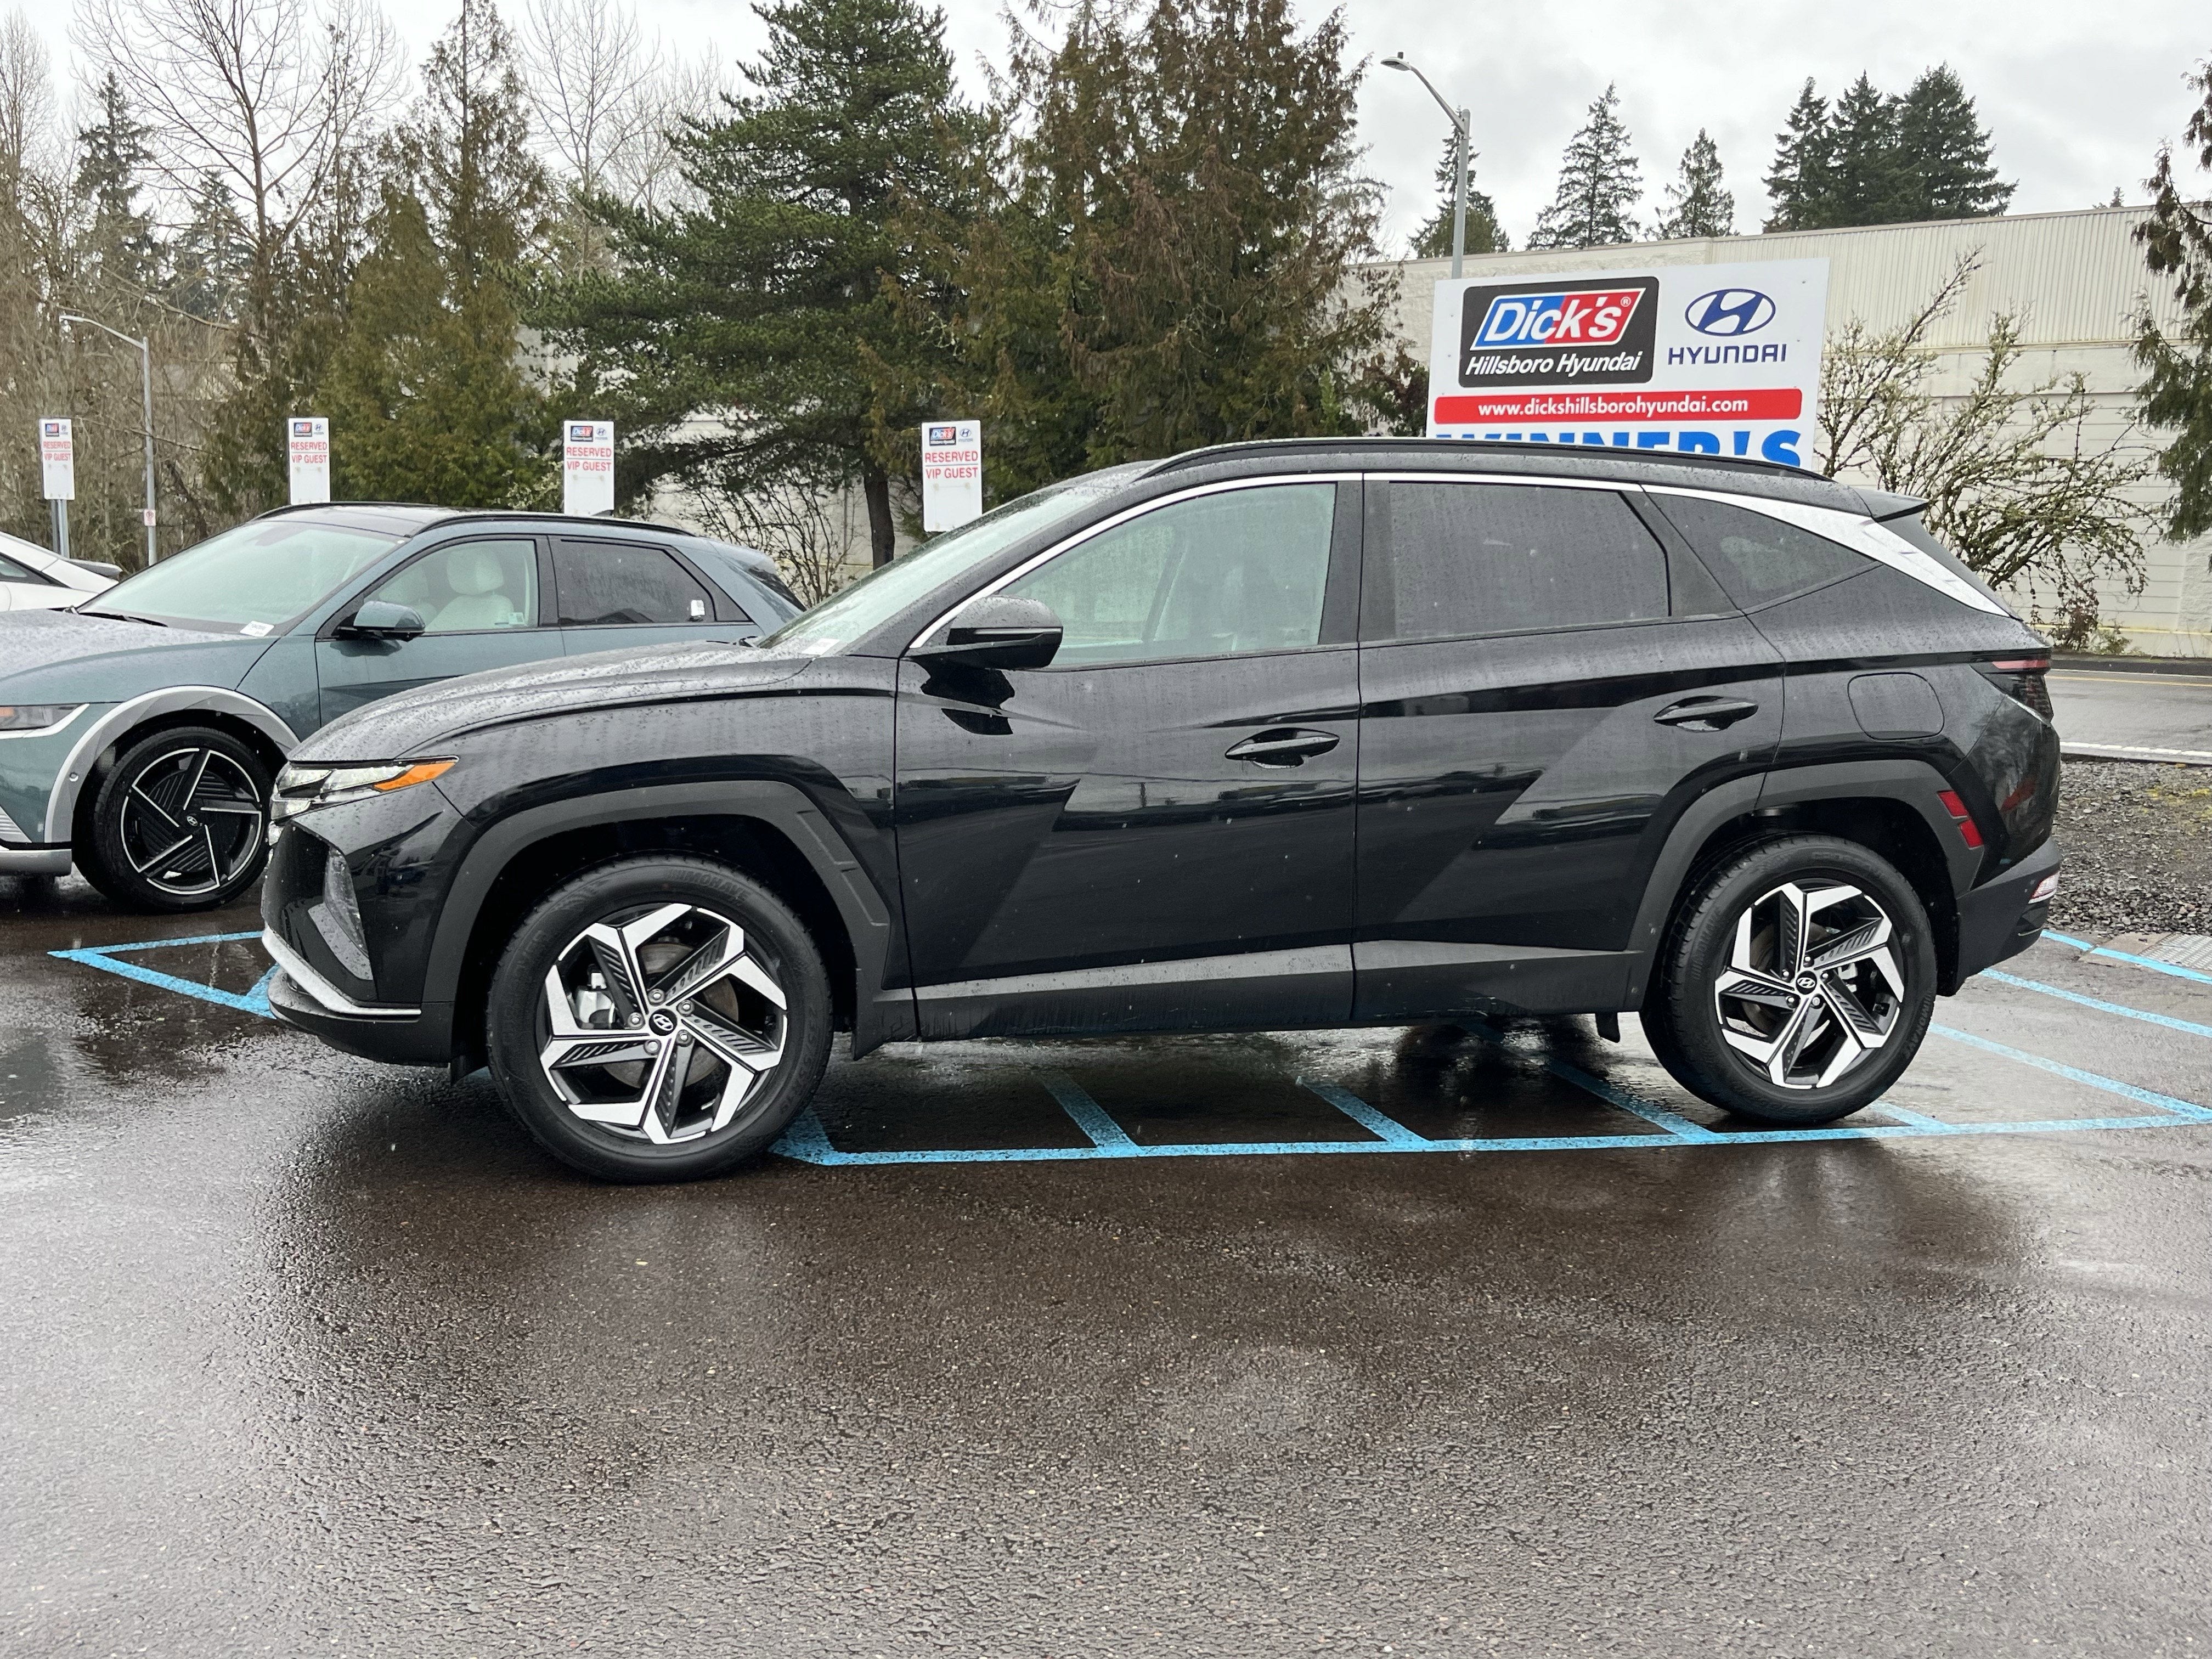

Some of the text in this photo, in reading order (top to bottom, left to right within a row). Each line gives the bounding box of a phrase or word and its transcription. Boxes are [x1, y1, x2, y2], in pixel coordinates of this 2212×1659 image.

[1483, 296, 1622, 342] Dick's
[1668, 343, 1787, 365] HYUNDAI
[1465, 351, 1643, 377] Hillsboro Hyundai
[1478, 394, 1748, 418] www.dickshillsborohyundai.com
[291, 442, 328, 450] RESERVED
[566, 447, 612, 458] RESERVED
[924, 450, 979, 463] RESERVED
[291, 455, 328, 464] VIP GUEST
[567, 461, 612, 471] VIP GUEST
[926, 467, 979, 479] VIP GUEST
